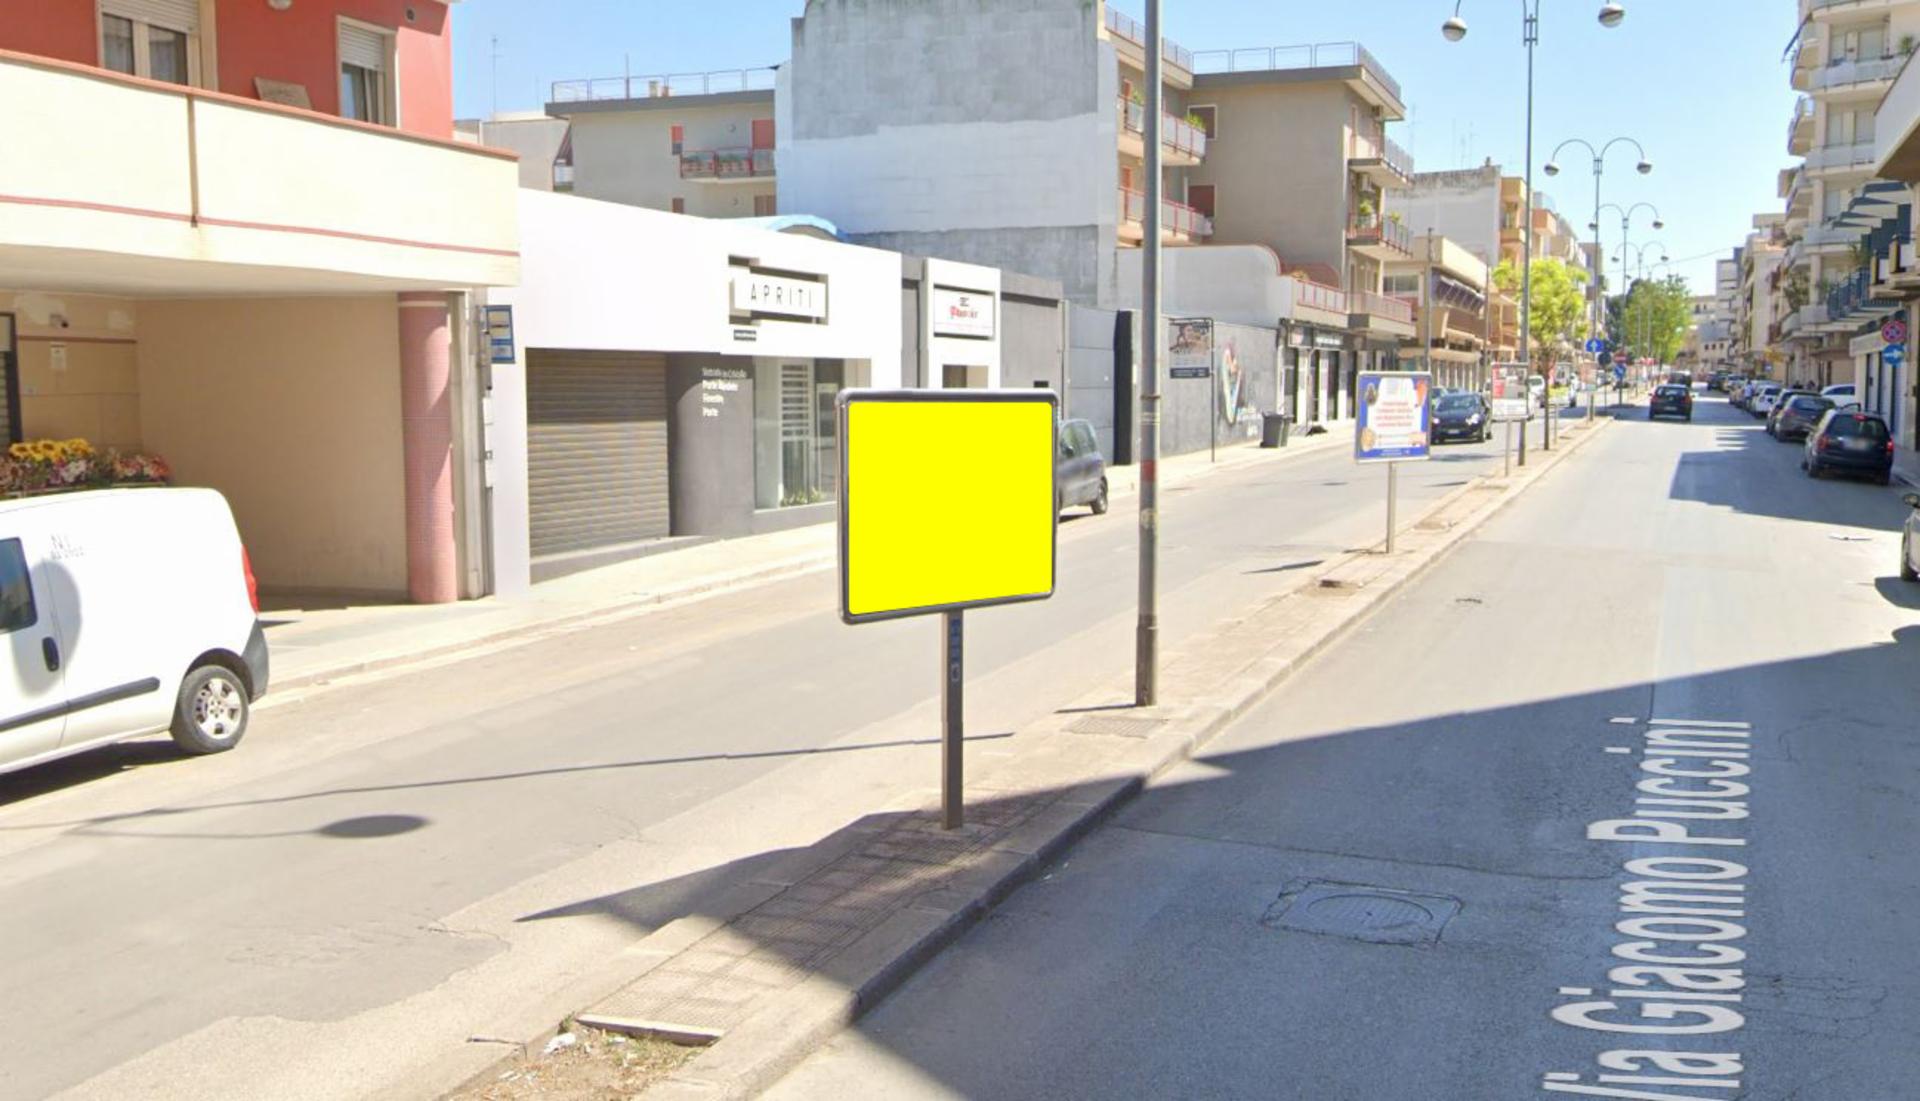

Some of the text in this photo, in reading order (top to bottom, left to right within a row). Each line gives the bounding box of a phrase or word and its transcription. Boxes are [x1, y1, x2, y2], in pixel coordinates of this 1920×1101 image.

[750, 283, 812, 308] APRITI
[1586, 717, 1751, 846] Puccini
[1550, 856, 1748, 1035] Giacomo
